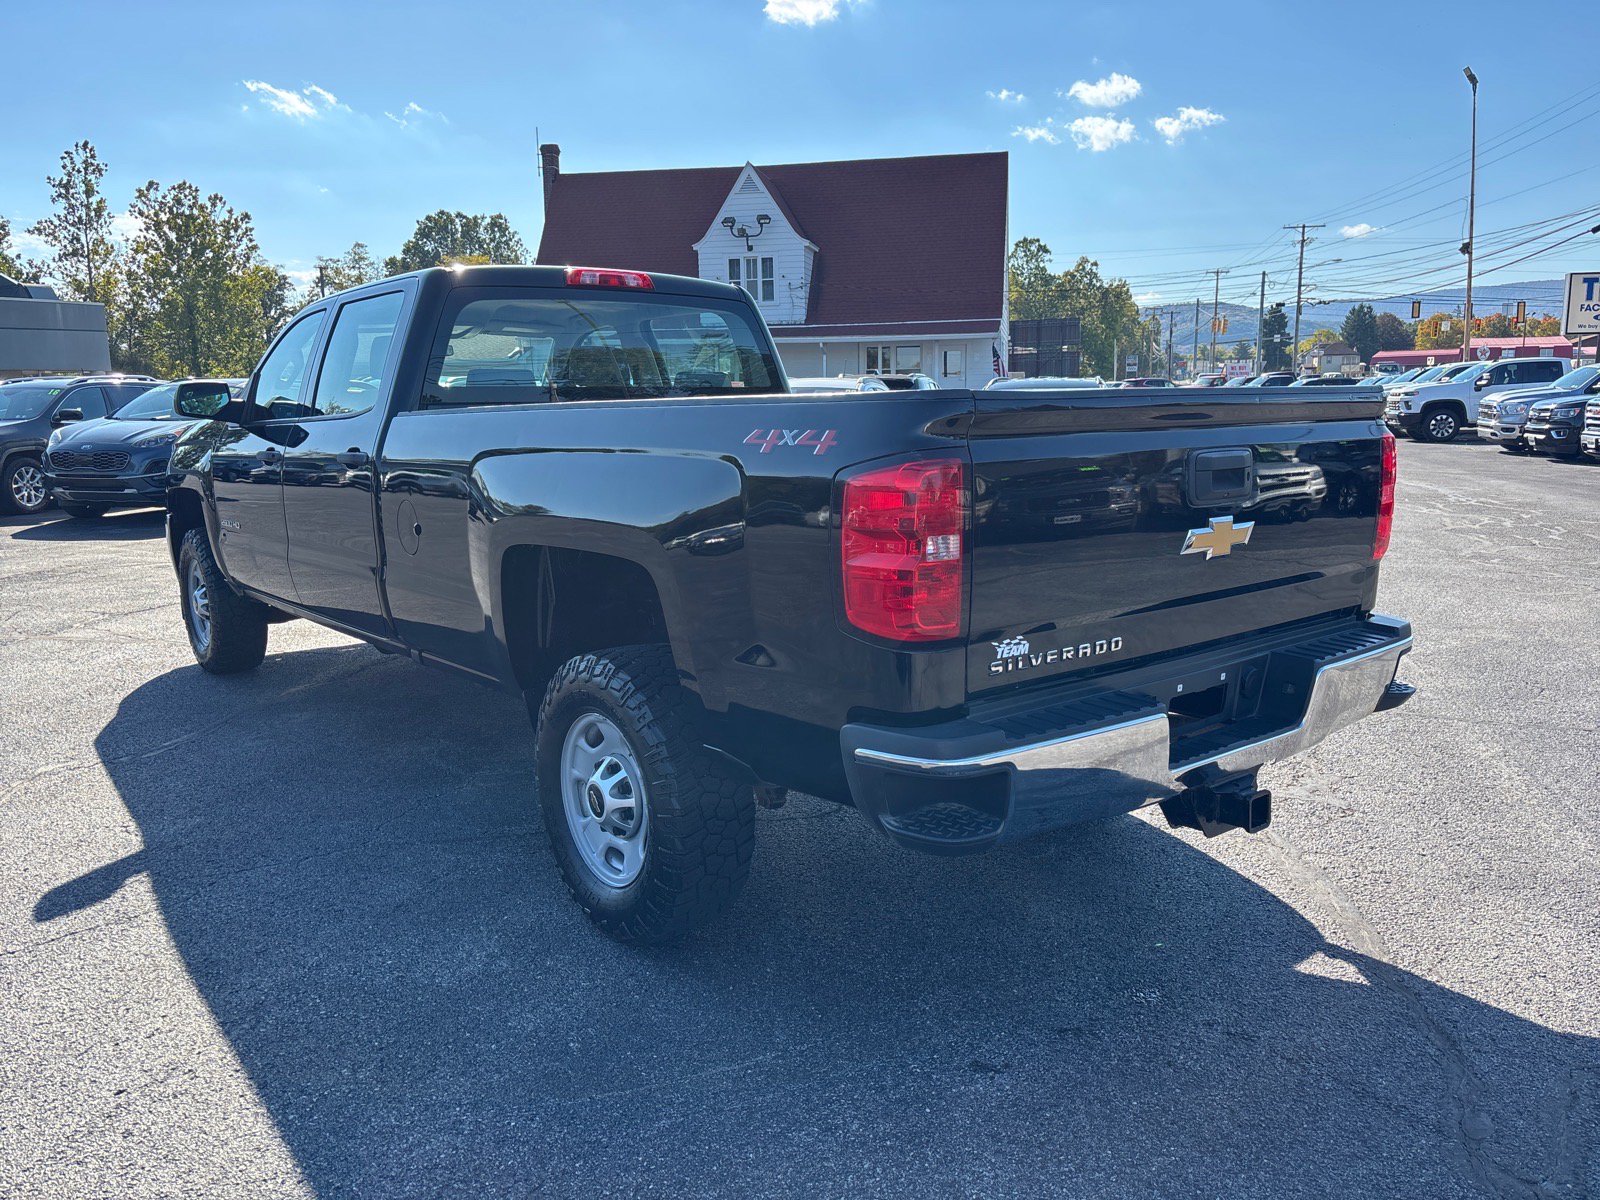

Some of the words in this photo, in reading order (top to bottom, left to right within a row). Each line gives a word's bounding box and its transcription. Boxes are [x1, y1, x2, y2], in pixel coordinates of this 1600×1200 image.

[1583, 277, 1600, 301] T
[1580, 303, 1600, 312] FAC
[48, 388, 61, 396] 16
[743, 428, 838, 455] 4x4
[989, 636, 1123, 675] SILVERADO
[996, 642, 1030, 659] TEAM
